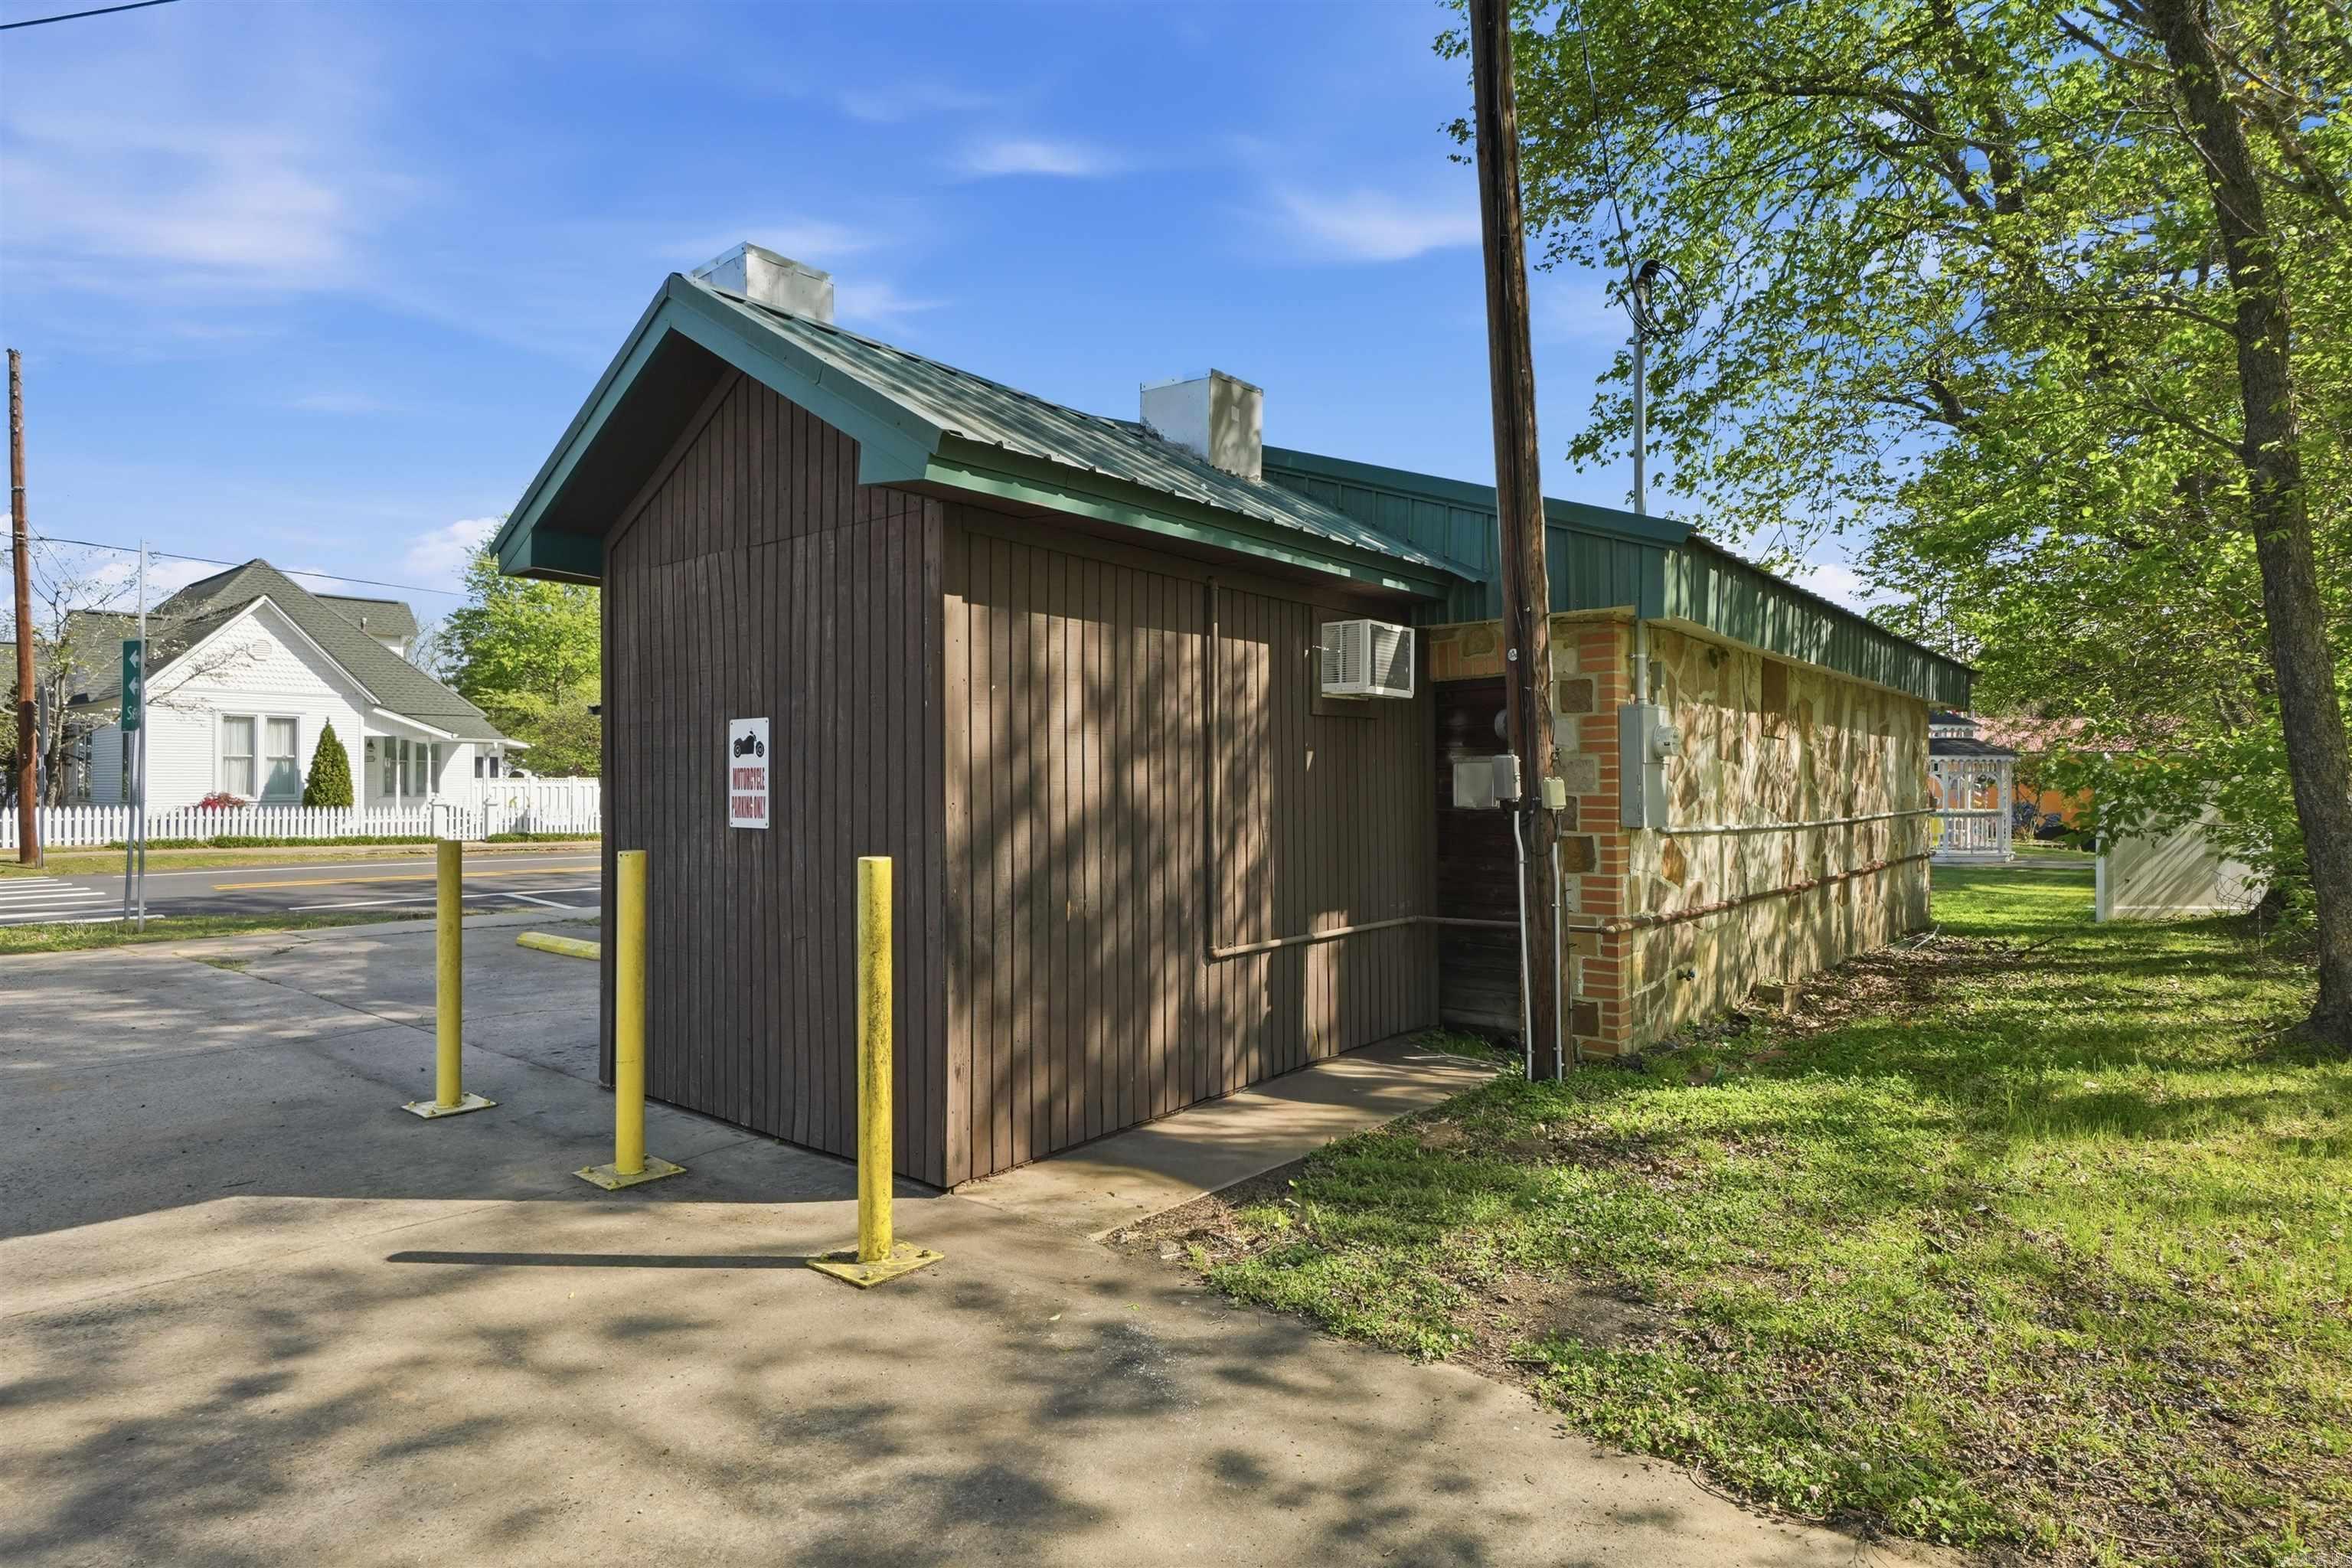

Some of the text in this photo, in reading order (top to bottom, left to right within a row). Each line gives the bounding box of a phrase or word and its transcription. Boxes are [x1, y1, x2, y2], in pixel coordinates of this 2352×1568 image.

[733, 767, 765, 790] MOTORCYCLE
[732, 795, 766, 819] PARKING ONLY
